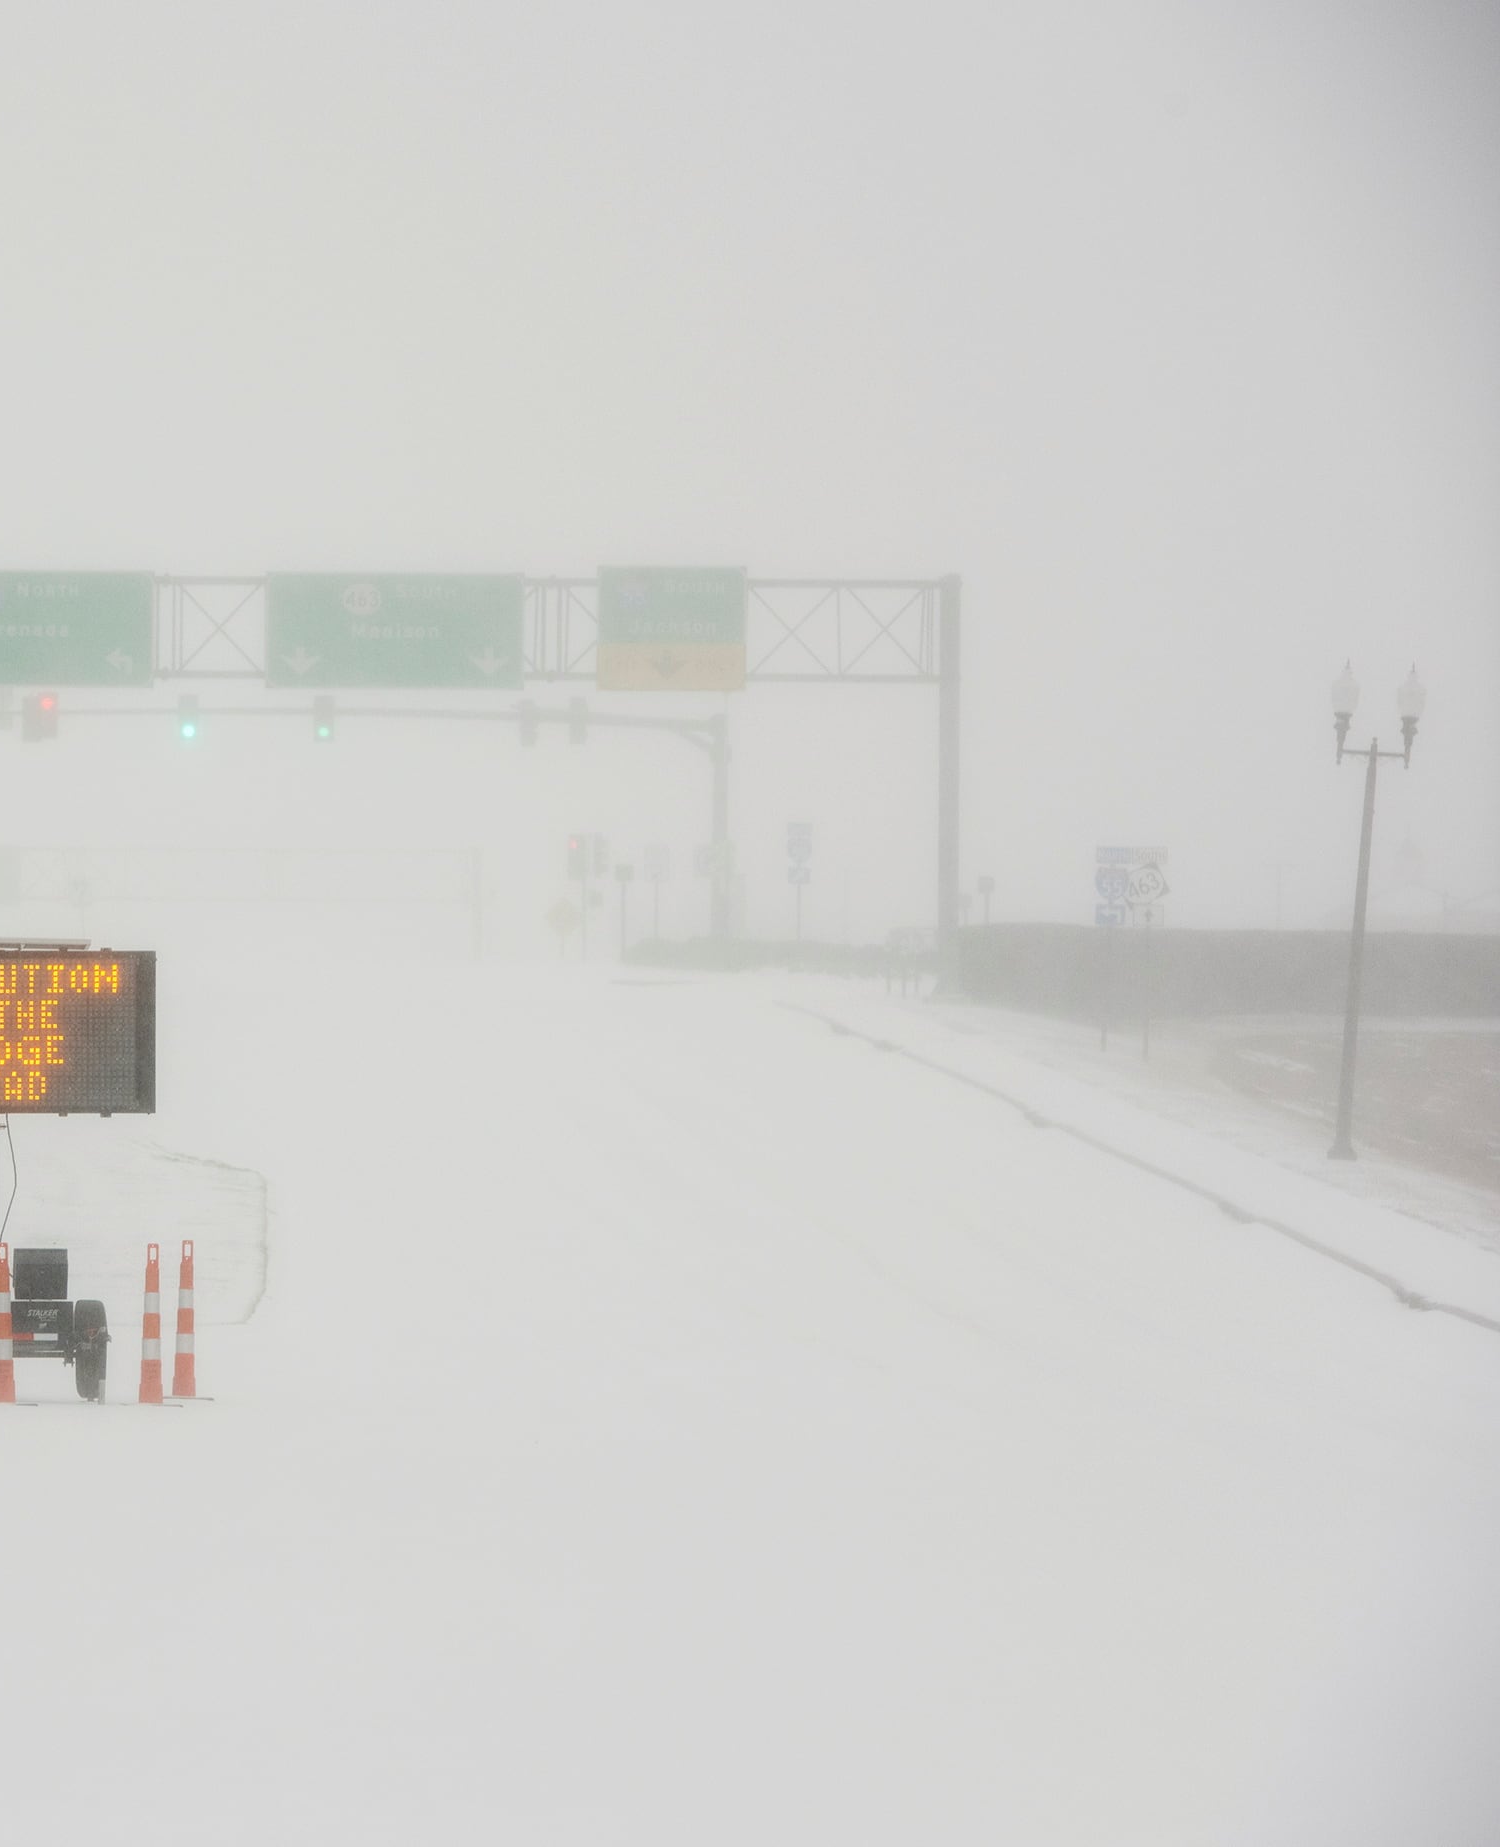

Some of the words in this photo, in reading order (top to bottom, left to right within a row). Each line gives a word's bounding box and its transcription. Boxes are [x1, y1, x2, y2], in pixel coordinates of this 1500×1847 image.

[346, 591, 379, 607] 463
[351, 623, 439, 639] Madison
[1129, 872, 1160, 897] 463
[27, 1308, 60, 1317] STALKER
